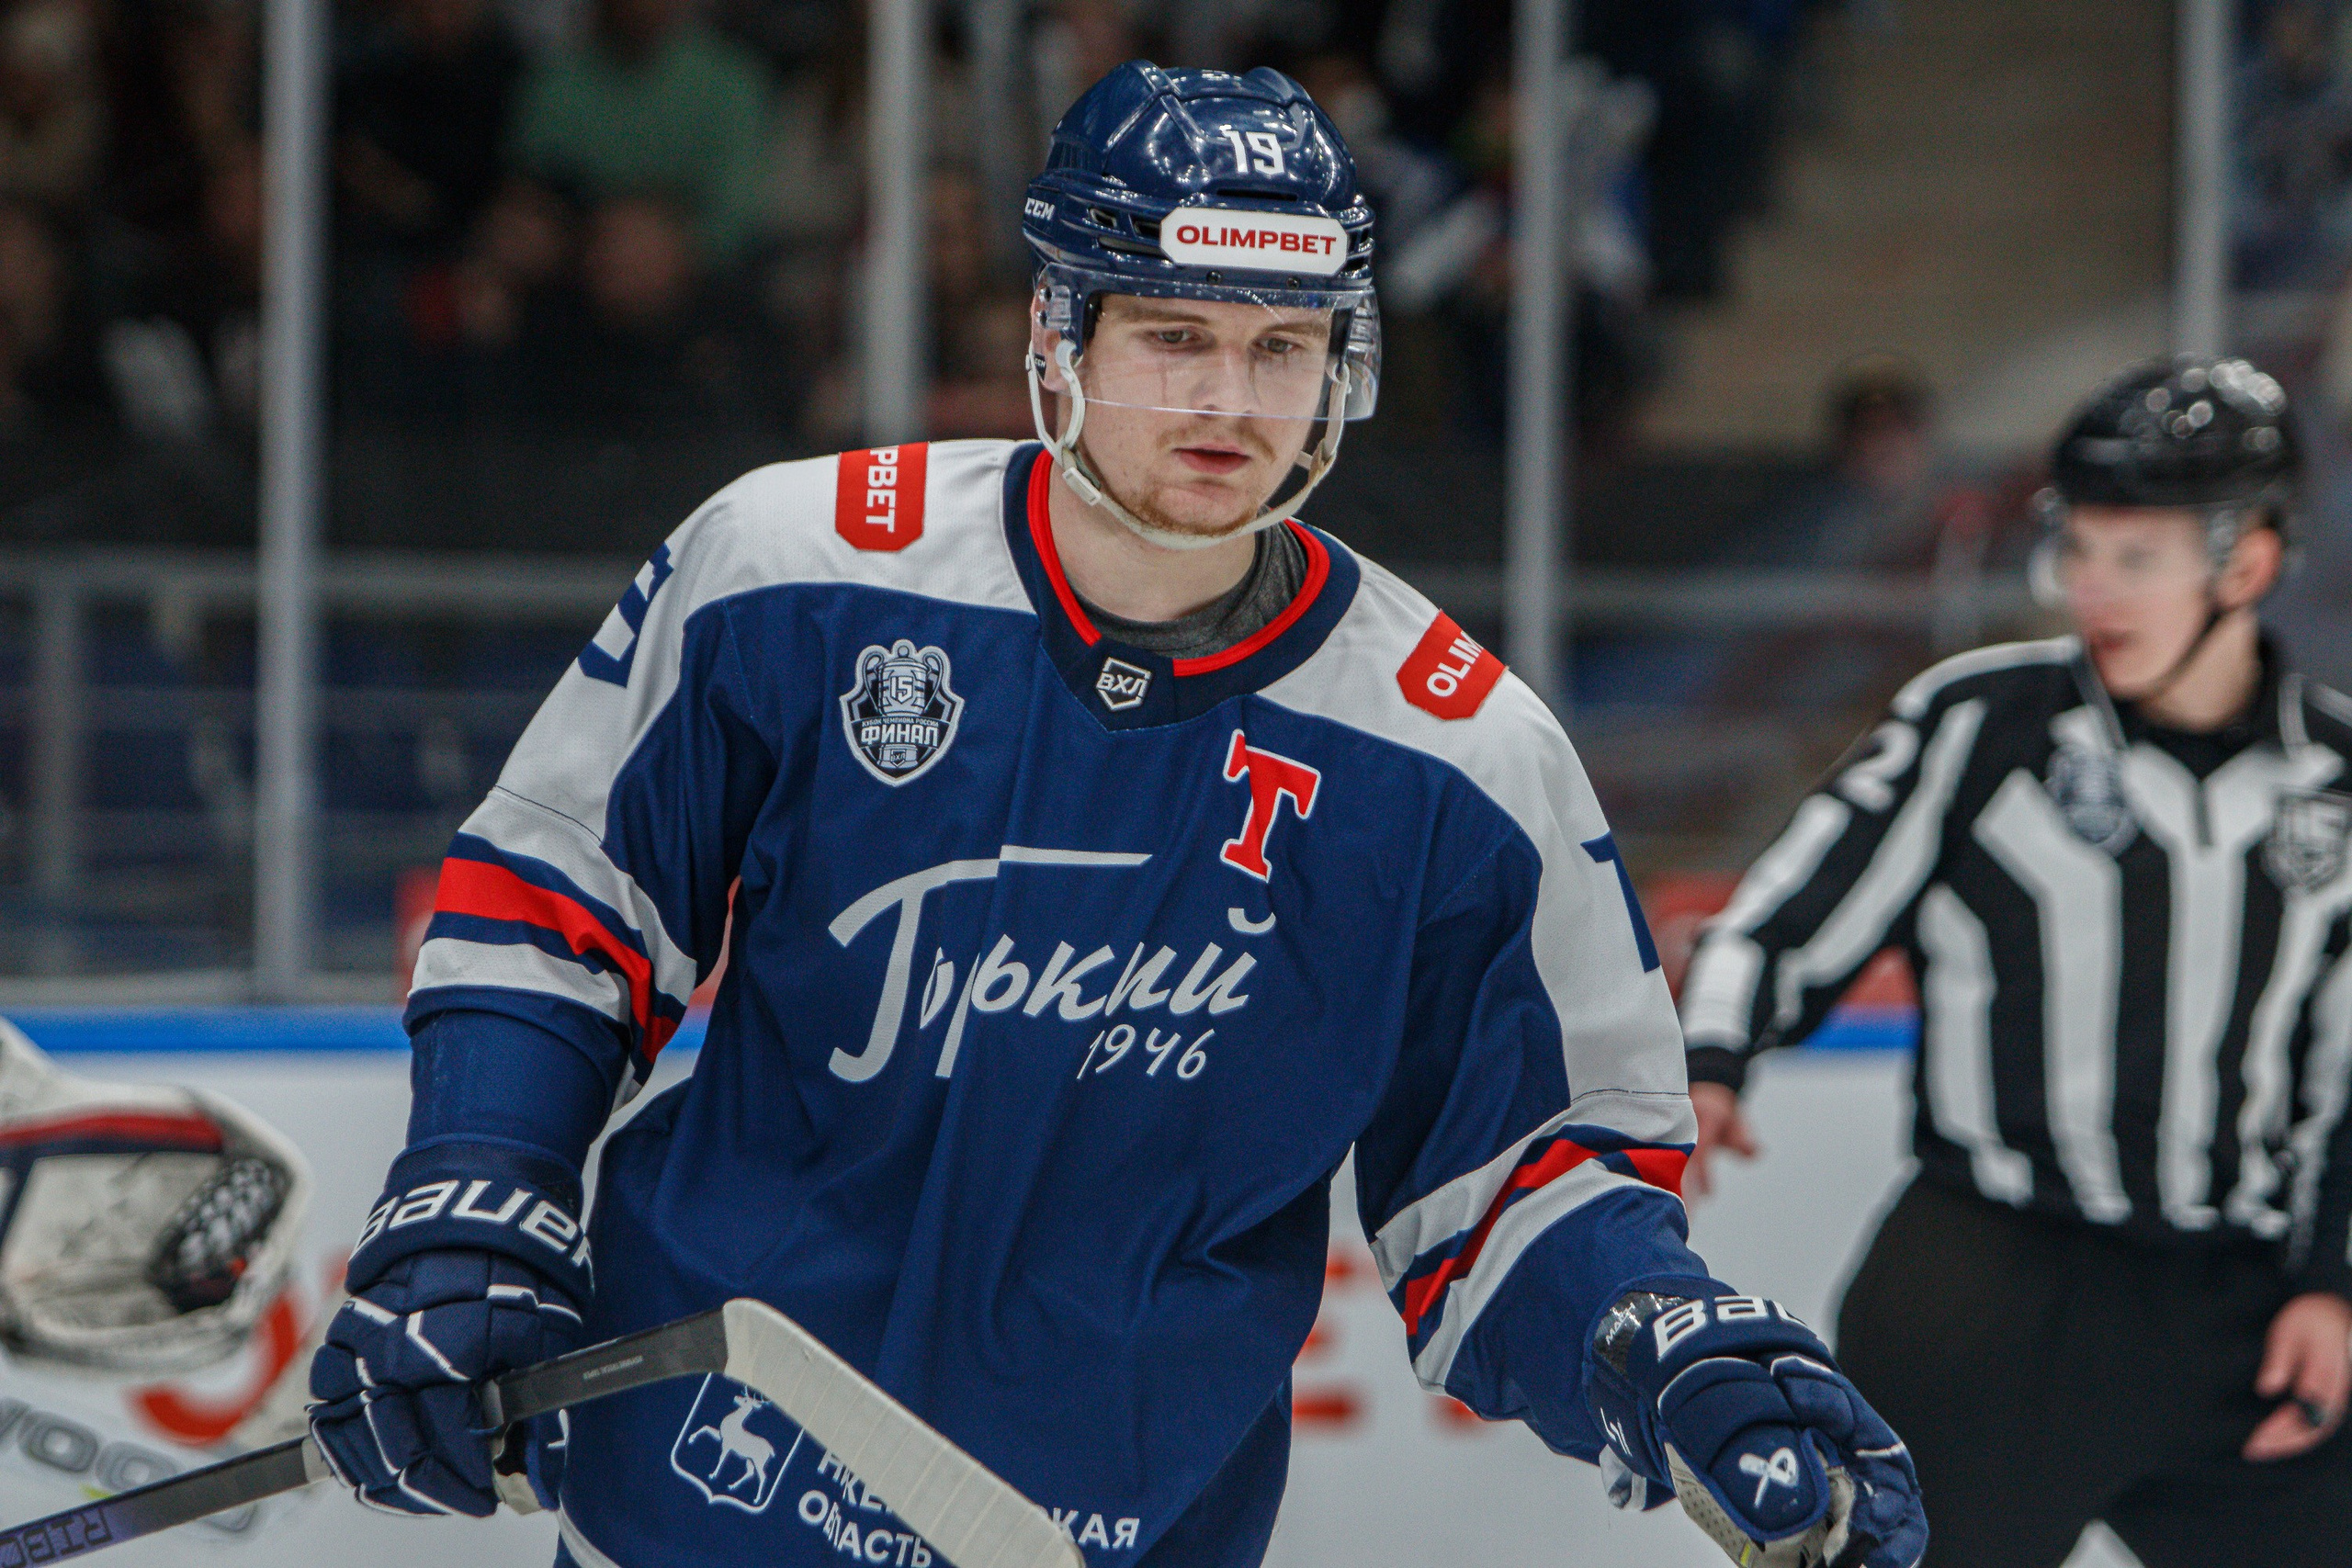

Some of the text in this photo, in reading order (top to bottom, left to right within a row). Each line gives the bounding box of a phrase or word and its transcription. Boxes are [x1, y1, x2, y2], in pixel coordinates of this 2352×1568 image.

[1220, 125, 1285, 175] 19
[1024, 197, 1056, 220] CCM
[1176, 224, 1338, 256] OLIMPBET
[861, 723, 939, 747] ФИНАЛ
[1076, 1023, 1216, 1080] 1946
